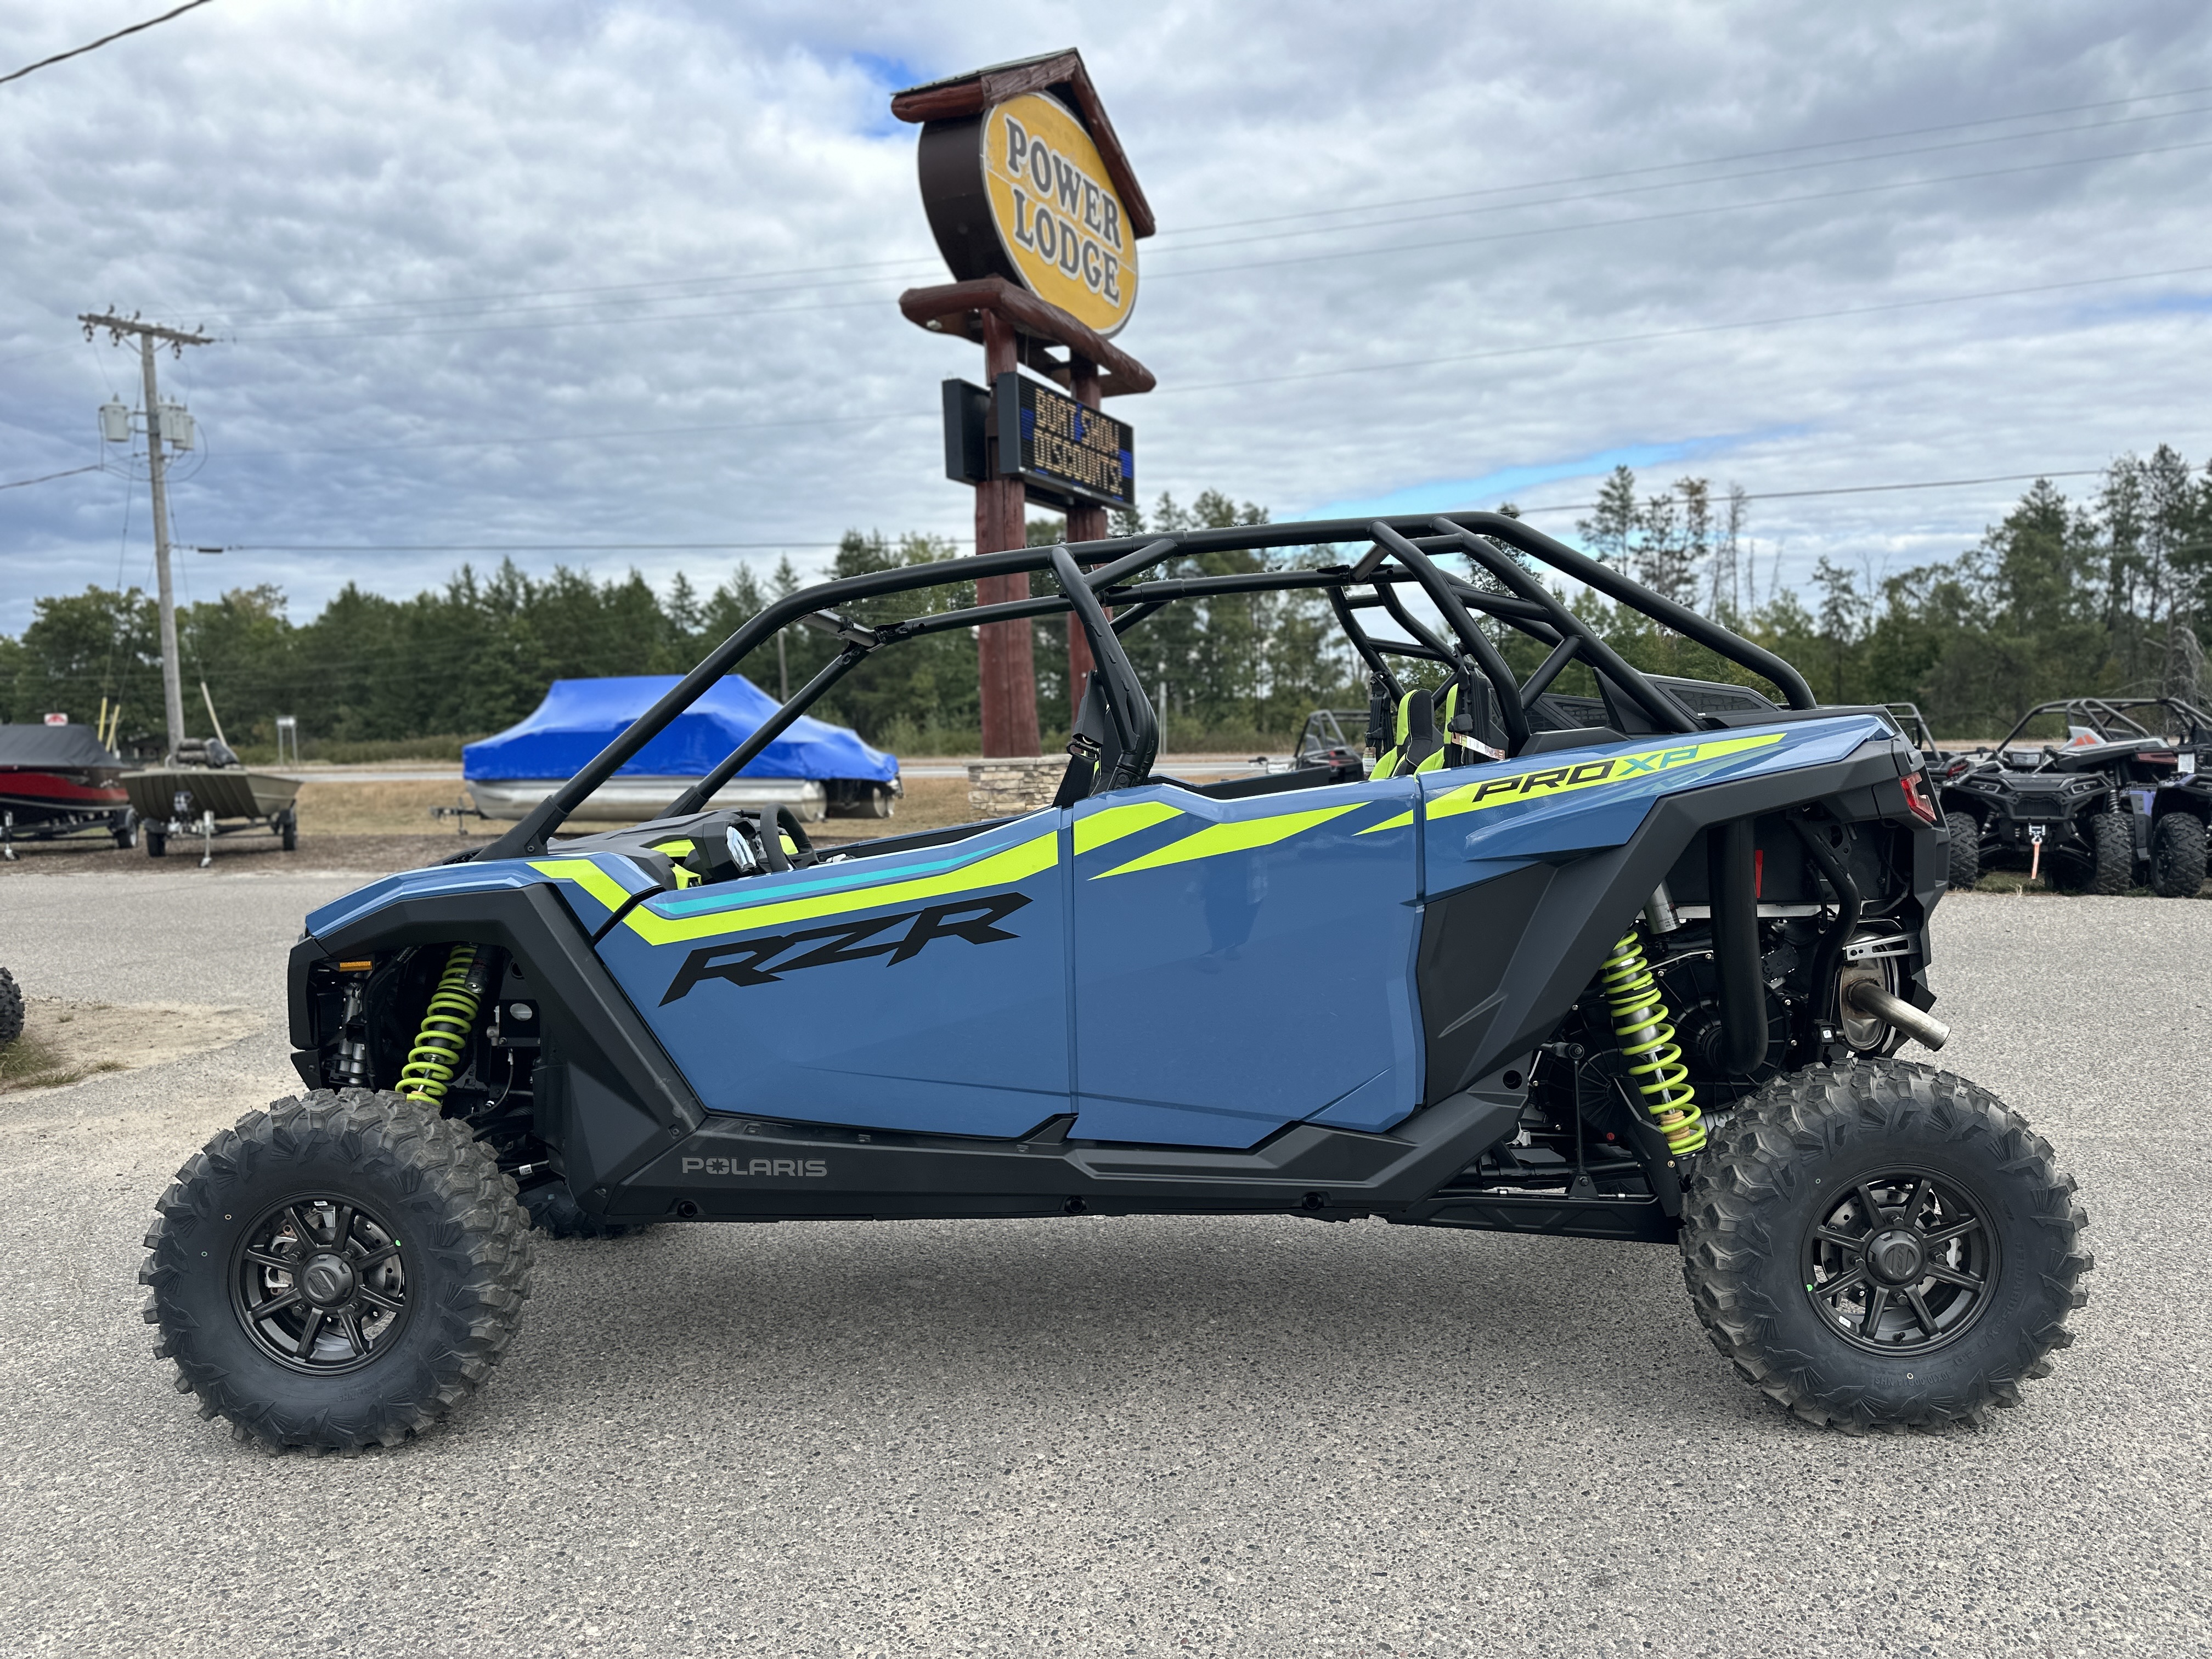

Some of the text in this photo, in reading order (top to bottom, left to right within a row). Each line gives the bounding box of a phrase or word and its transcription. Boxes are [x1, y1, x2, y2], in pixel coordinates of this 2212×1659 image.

[1006, 116, 1122, 251] POWER
[1014, 188, 1120, 304] LODGE
[1035, 388, 1077, 440] BOAT
[658, 891, 1034, 1007] RZR
[682, 1157, 827, 1177] POLARIS
[1874, 1375, 1894, 1385] NHS
